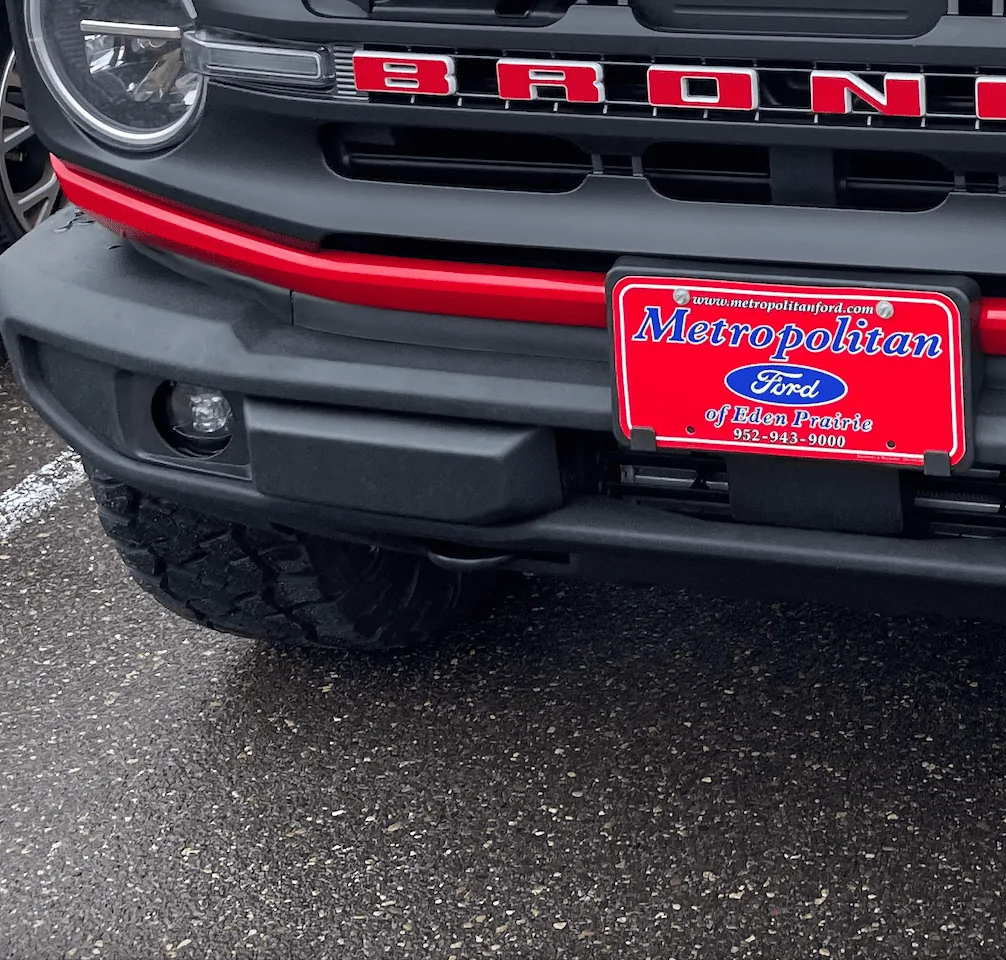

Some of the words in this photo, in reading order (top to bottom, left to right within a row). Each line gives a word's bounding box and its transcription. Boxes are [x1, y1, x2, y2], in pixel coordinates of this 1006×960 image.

[692, 293, 874, 316] www.metropolitanford.com
[632, 306, 943, 361] Metropolitan
[750, 368, 821, 399] Ford
[705, 404, 730, 428] of
[731, 406, 787, 426] Eden
[792, 410, 873, 432] Prairie
[733, 428, 846, 448] 952-943-9000
